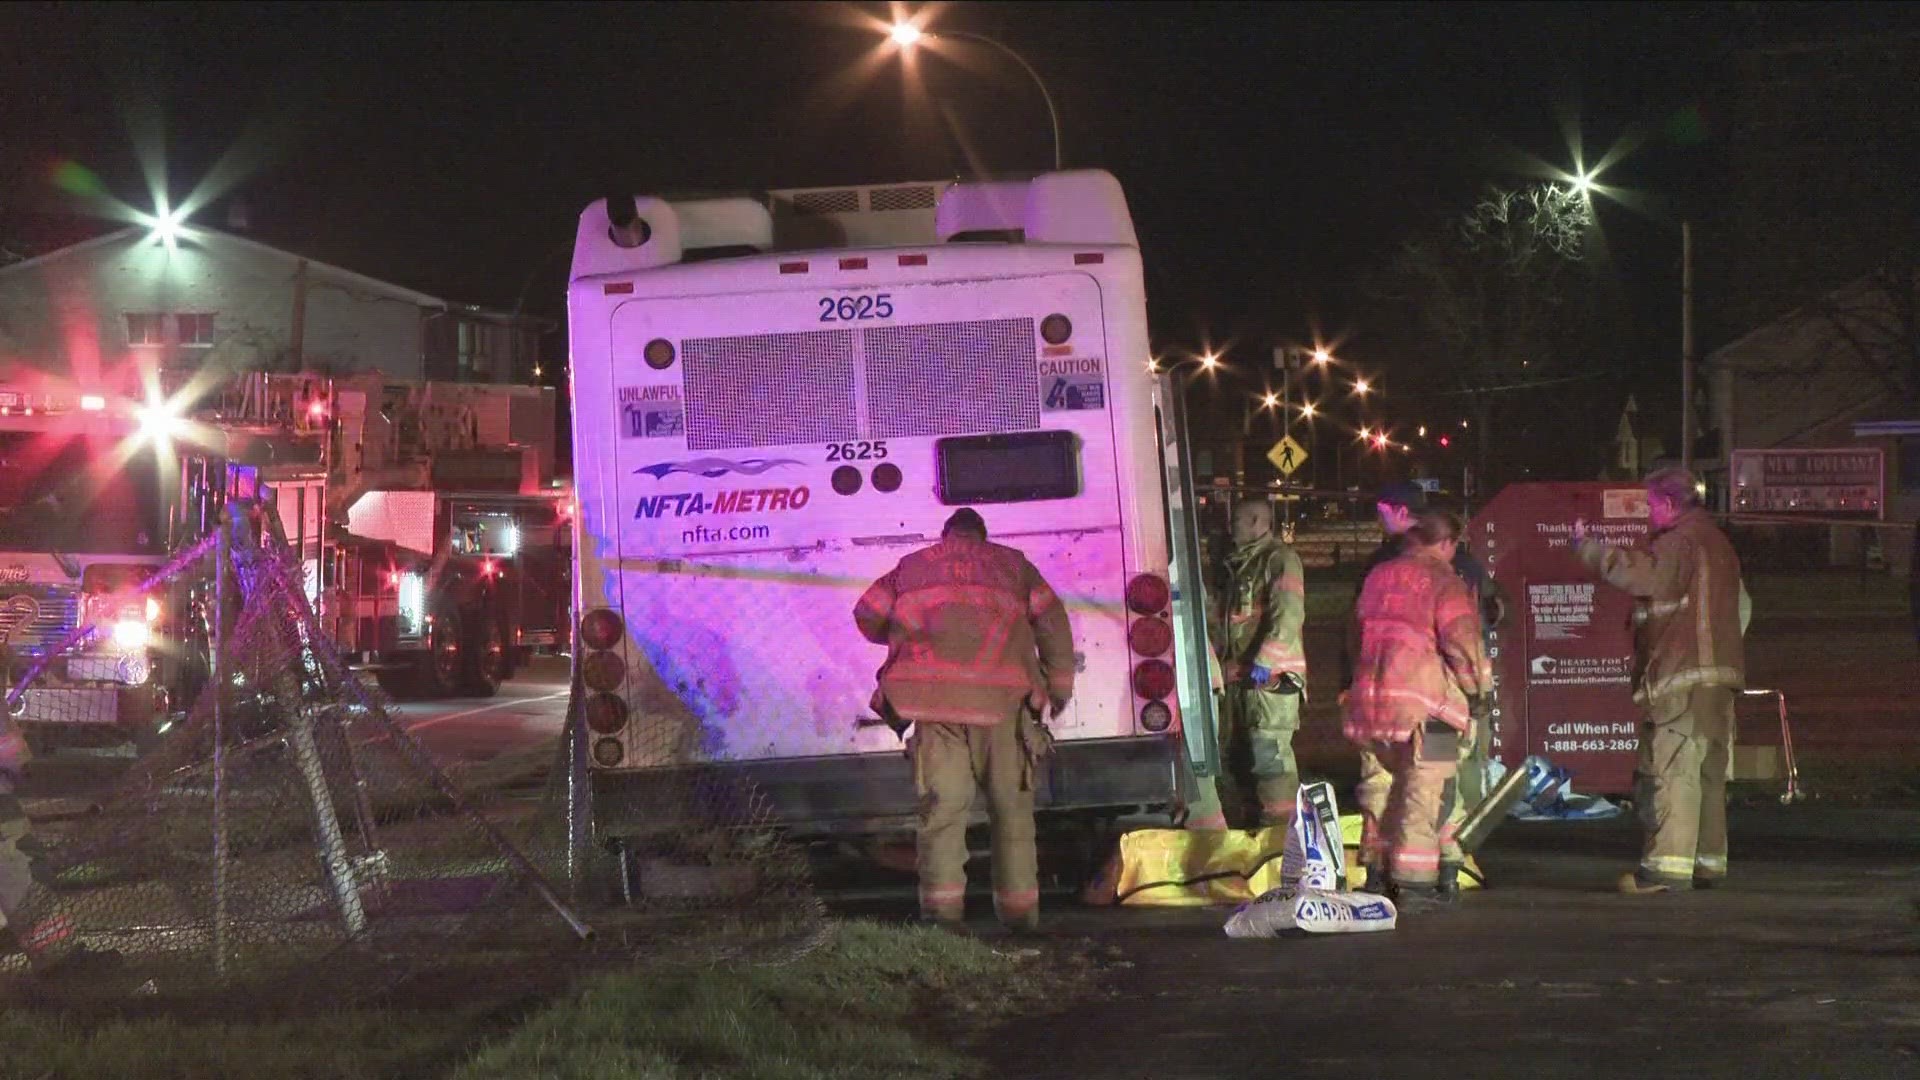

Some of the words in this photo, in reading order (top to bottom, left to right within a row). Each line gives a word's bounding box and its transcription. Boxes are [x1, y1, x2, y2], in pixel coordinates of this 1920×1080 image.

[819, 293, 894, 322] 2625
[1040, 358, 1100, 376] CAUTION
[618, 385, 683, 402] UNLAWFUL
[825, 441, 888, 462] 2625
[634, 485, 810, 520] NFTA-METRO
[682, 525, 769, 543] nfta.com
[1536, 523, 1572, 533] Thanks
[1591, 524, 1648, 535] supporting
[1560, 659, 1598, 667] HEARTS
[1548, 723, 1571, 735] Call
[1573, 723, 1609, 735] When
[1612, 722, 1635, 734] Full
[1543, 739, 1640, 752] 1-888-663-2867
